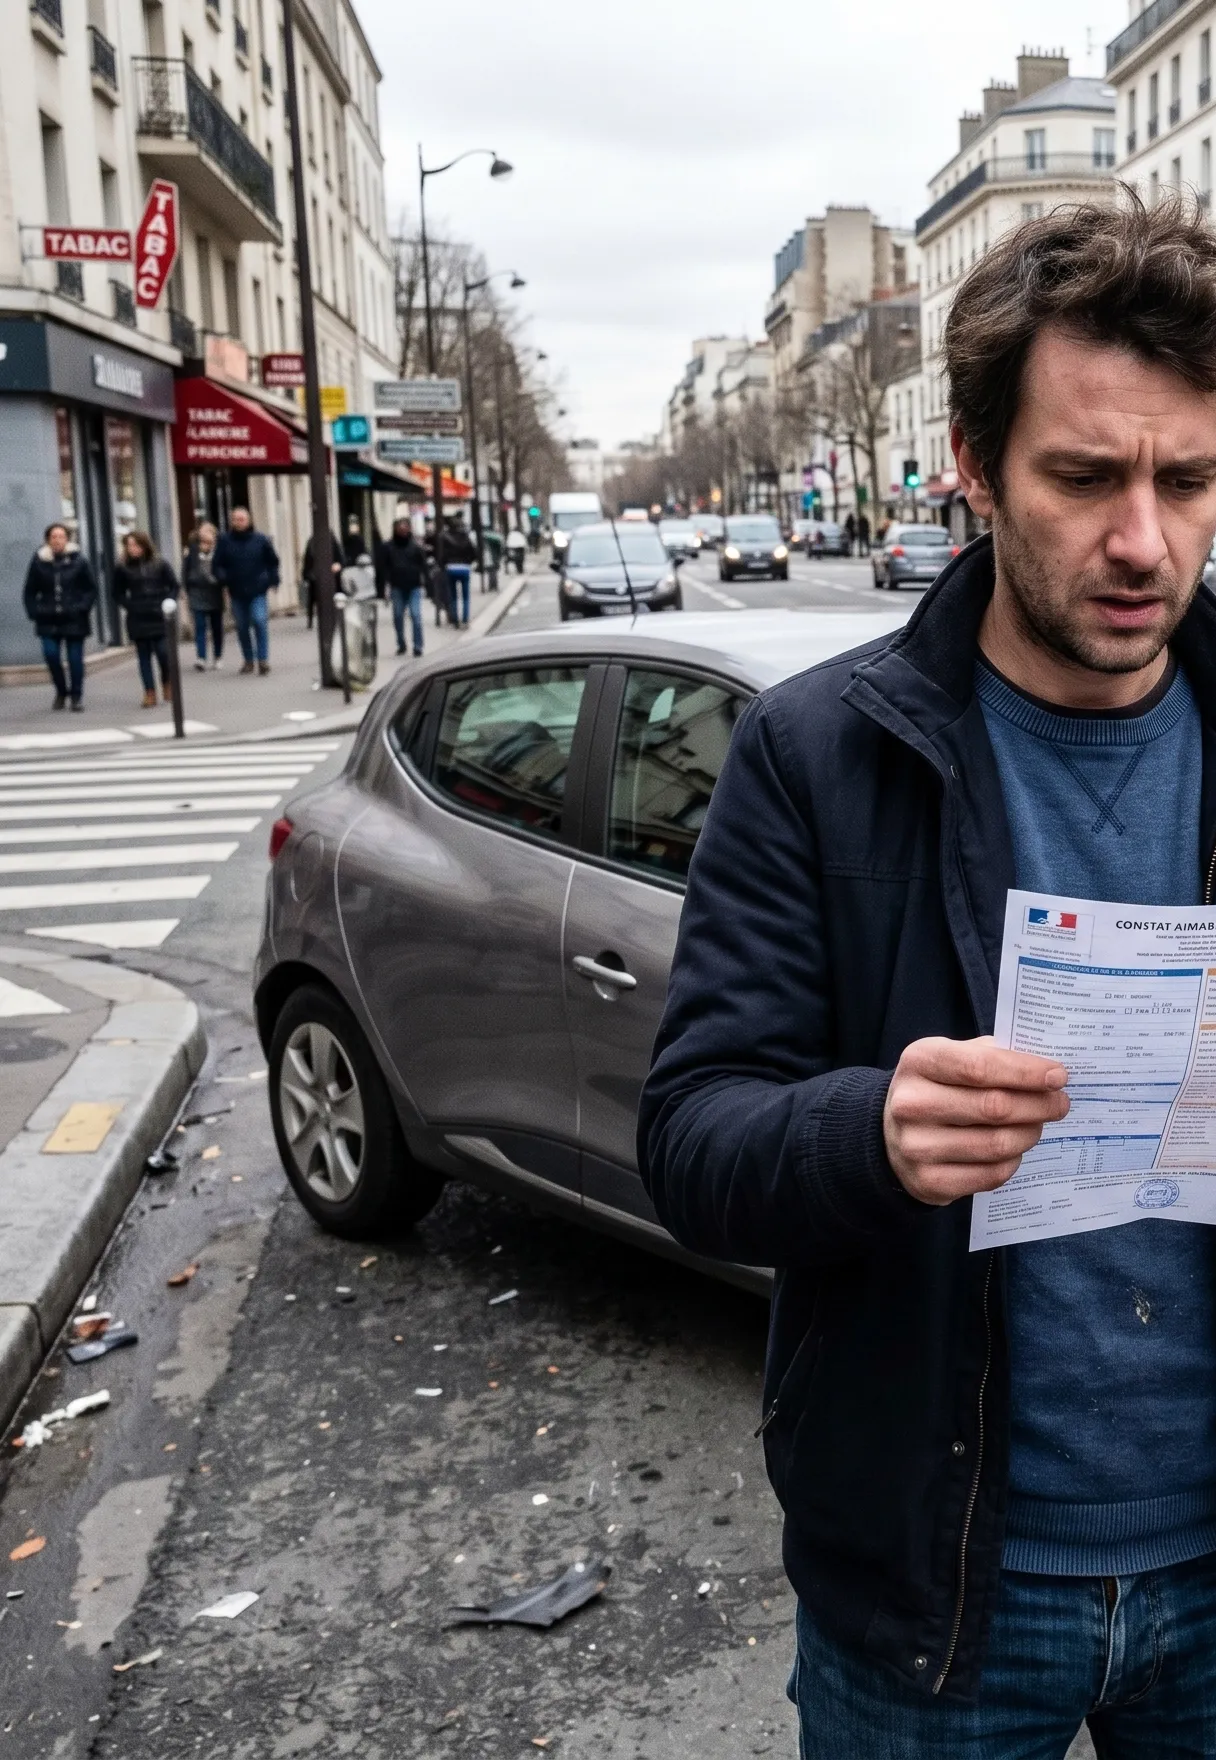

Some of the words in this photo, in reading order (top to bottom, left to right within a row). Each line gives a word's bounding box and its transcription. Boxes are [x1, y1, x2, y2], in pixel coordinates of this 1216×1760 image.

[46, 232, 129, 256] TABAC
[137, 191, 171, 299] TABAC
[187, 408, 233, 422] TABAC
[1116, 920, 1171, 931] CONSTAT
